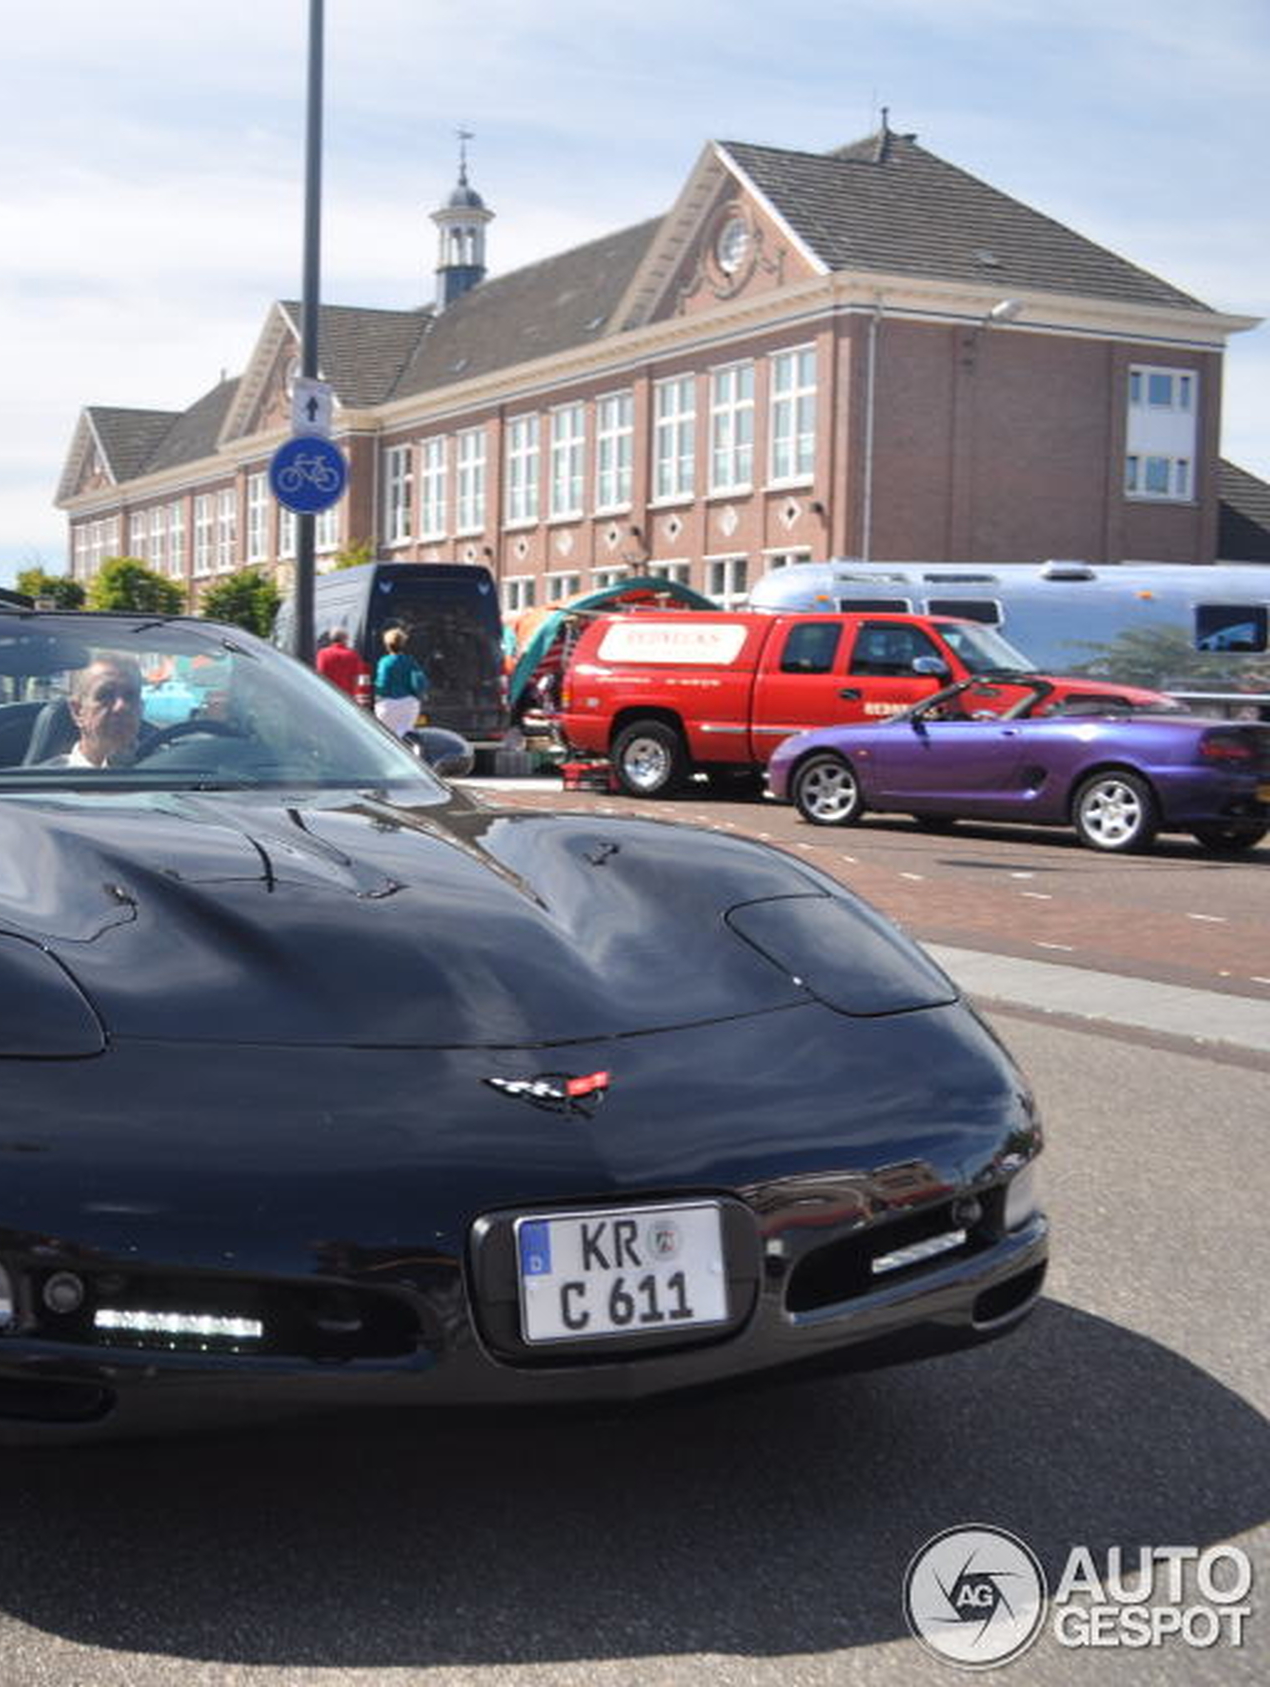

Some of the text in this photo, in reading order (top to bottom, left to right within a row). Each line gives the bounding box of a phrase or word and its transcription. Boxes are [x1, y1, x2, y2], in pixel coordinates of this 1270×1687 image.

[581, 1219, 642, 1271] KR
[560, 1271, 694, 1330] C 611
